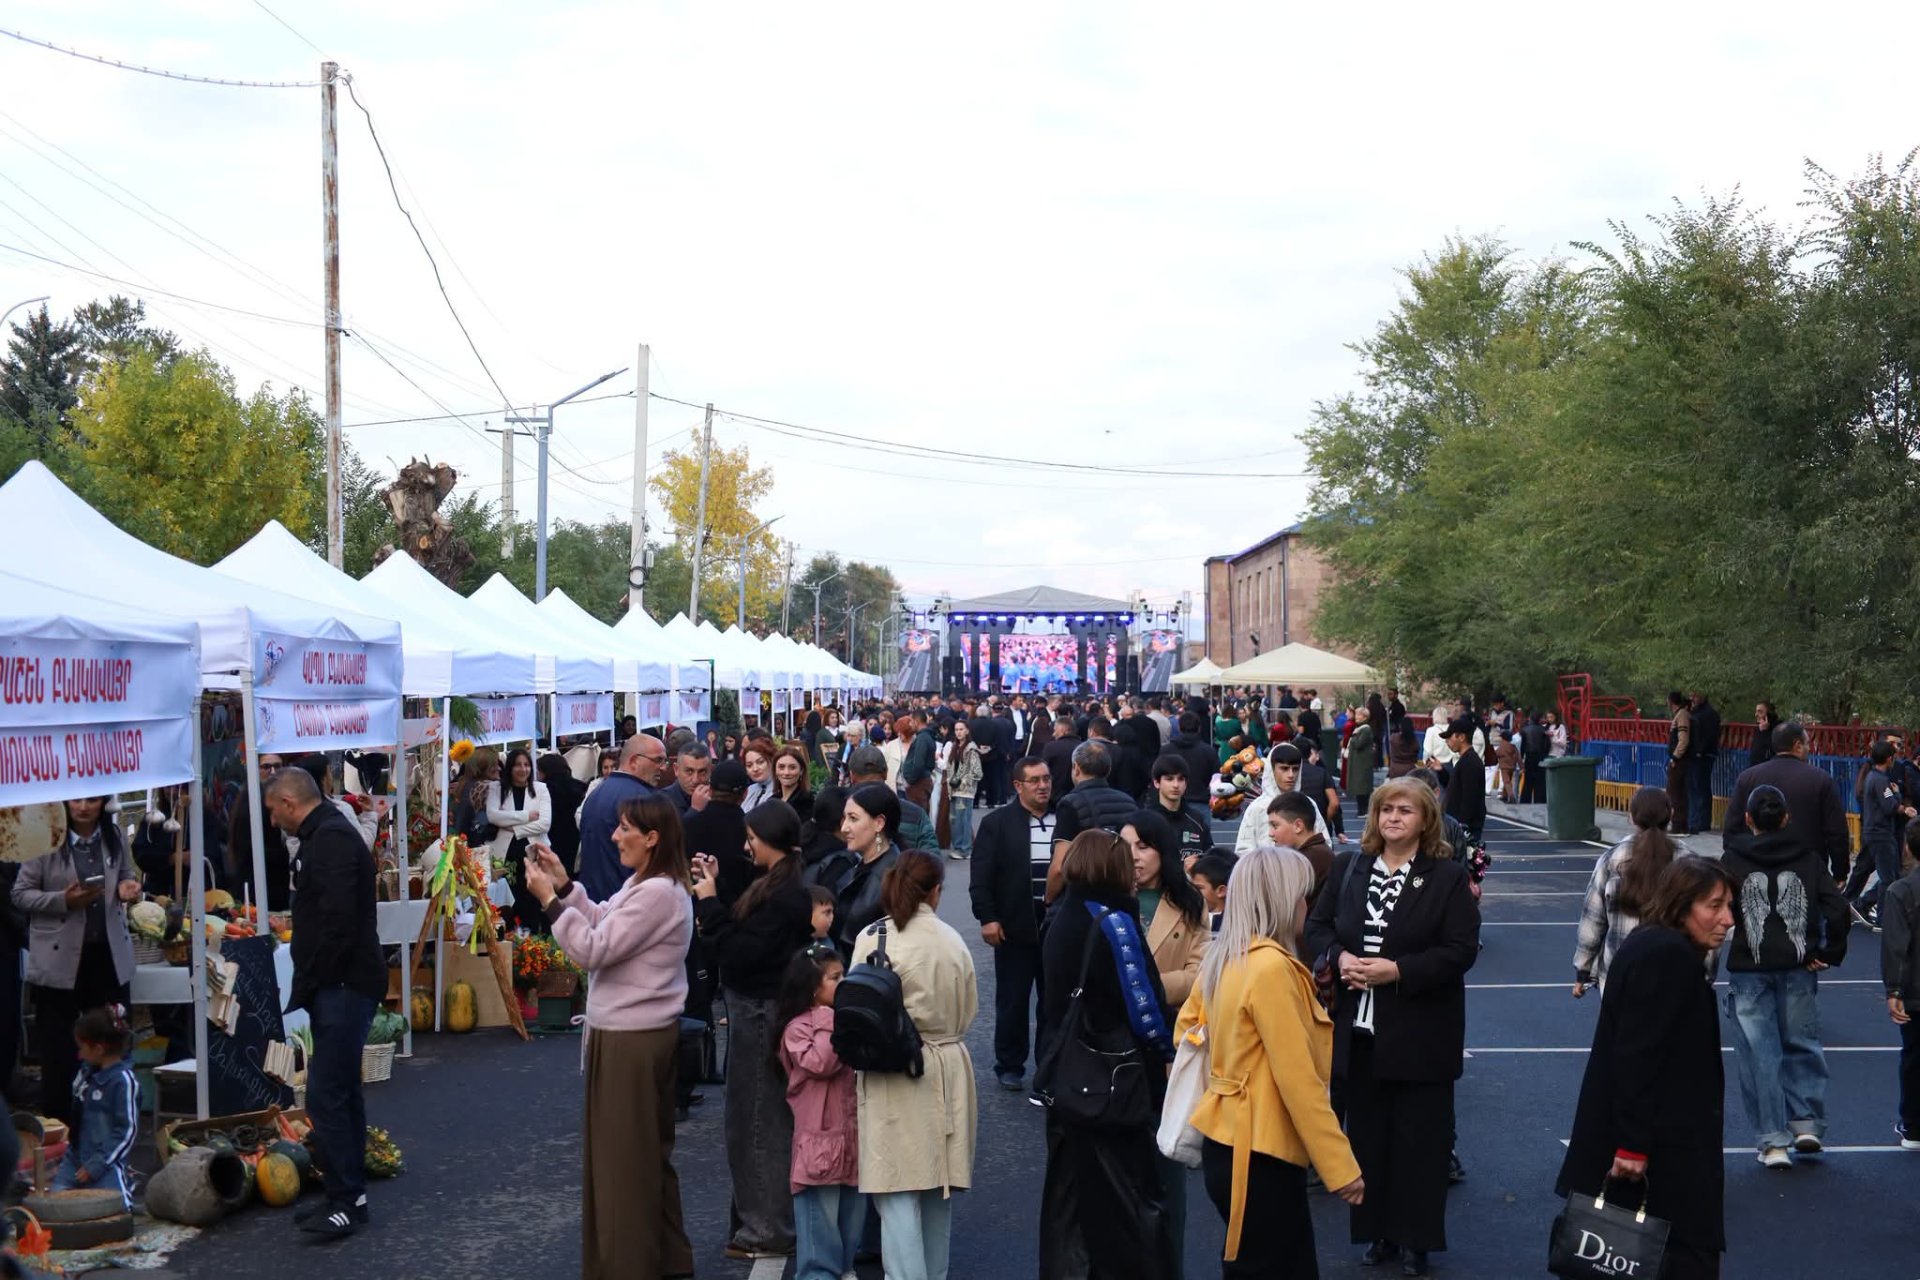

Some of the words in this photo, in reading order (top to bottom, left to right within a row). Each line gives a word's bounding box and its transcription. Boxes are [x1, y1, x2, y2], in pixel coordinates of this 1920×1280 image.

[52, 657, 131, 703] ԲՆԱԿԱՎԱՅՐ
[65, 728, 143, 778] ԲՆԱԿԱՎԱՅՐ
[1574, 1229, 1640, 1275] Dior
[1592, 1263, 1616, 1276] FRANCE
